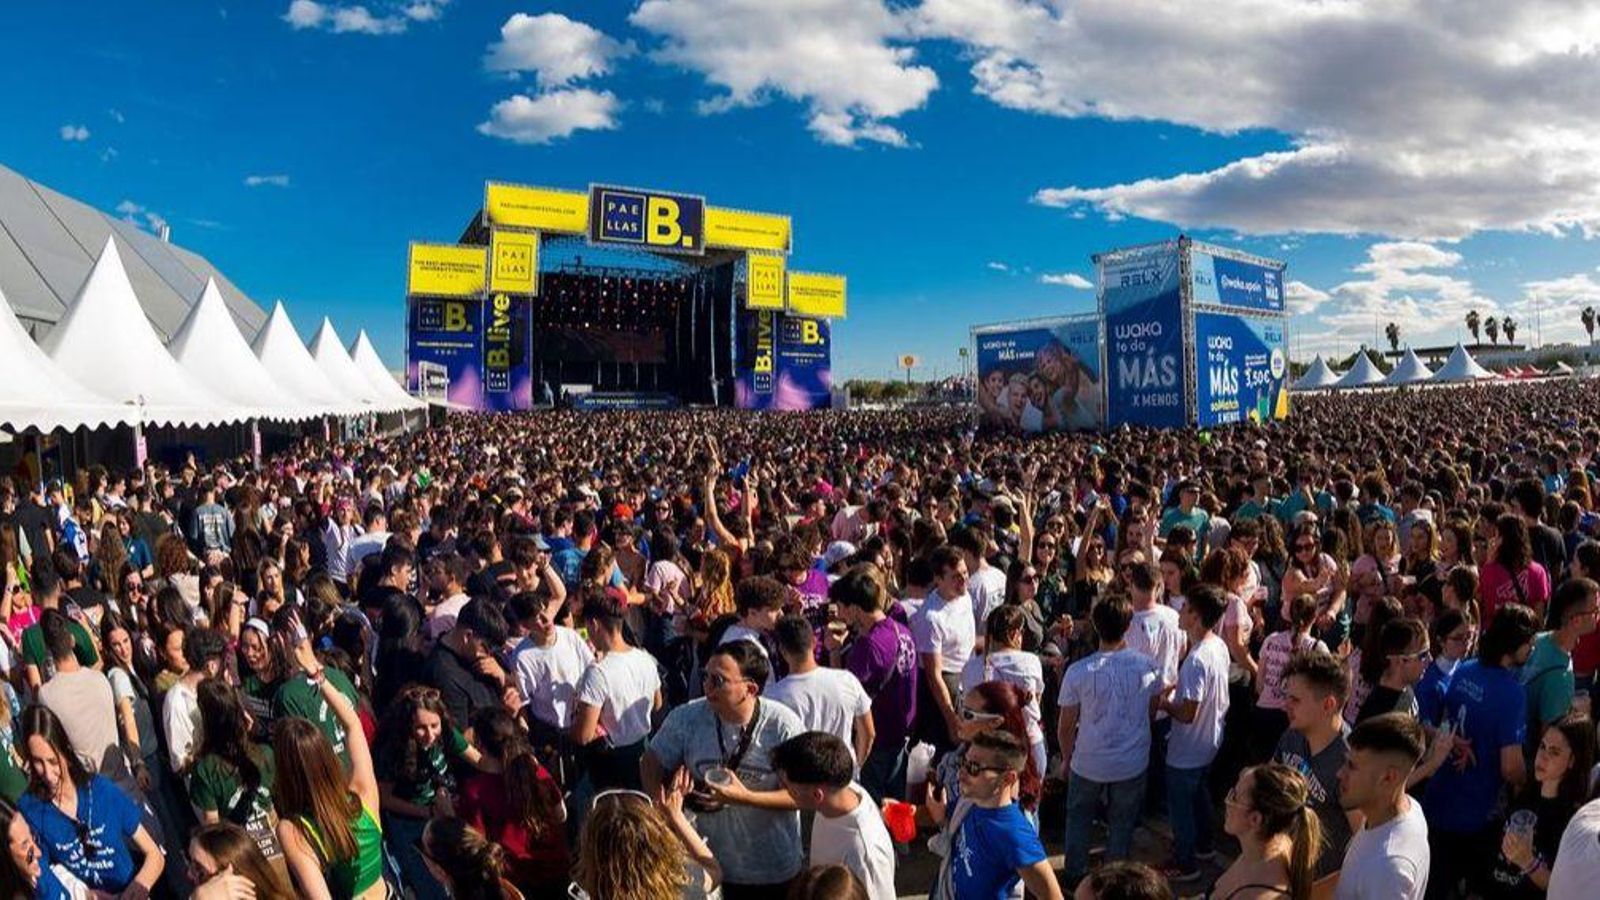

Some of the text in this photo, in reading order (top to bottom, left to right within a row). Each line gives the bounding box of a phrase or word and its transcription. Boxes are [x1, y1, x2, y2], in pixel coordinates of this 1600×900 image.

[608, 202, 639, 215] PAE
[647, 196, 692, 247] B.
[607, 220, 638, 233] LLAS
[446, 302, 473, 332] B.
[802, 320, 824, 345] B.
[1119, 346, 1176, 389] MÁS
[1209, 358, 1238, 397] MÁS
[1142, 393, 1179, 407] MENOS
